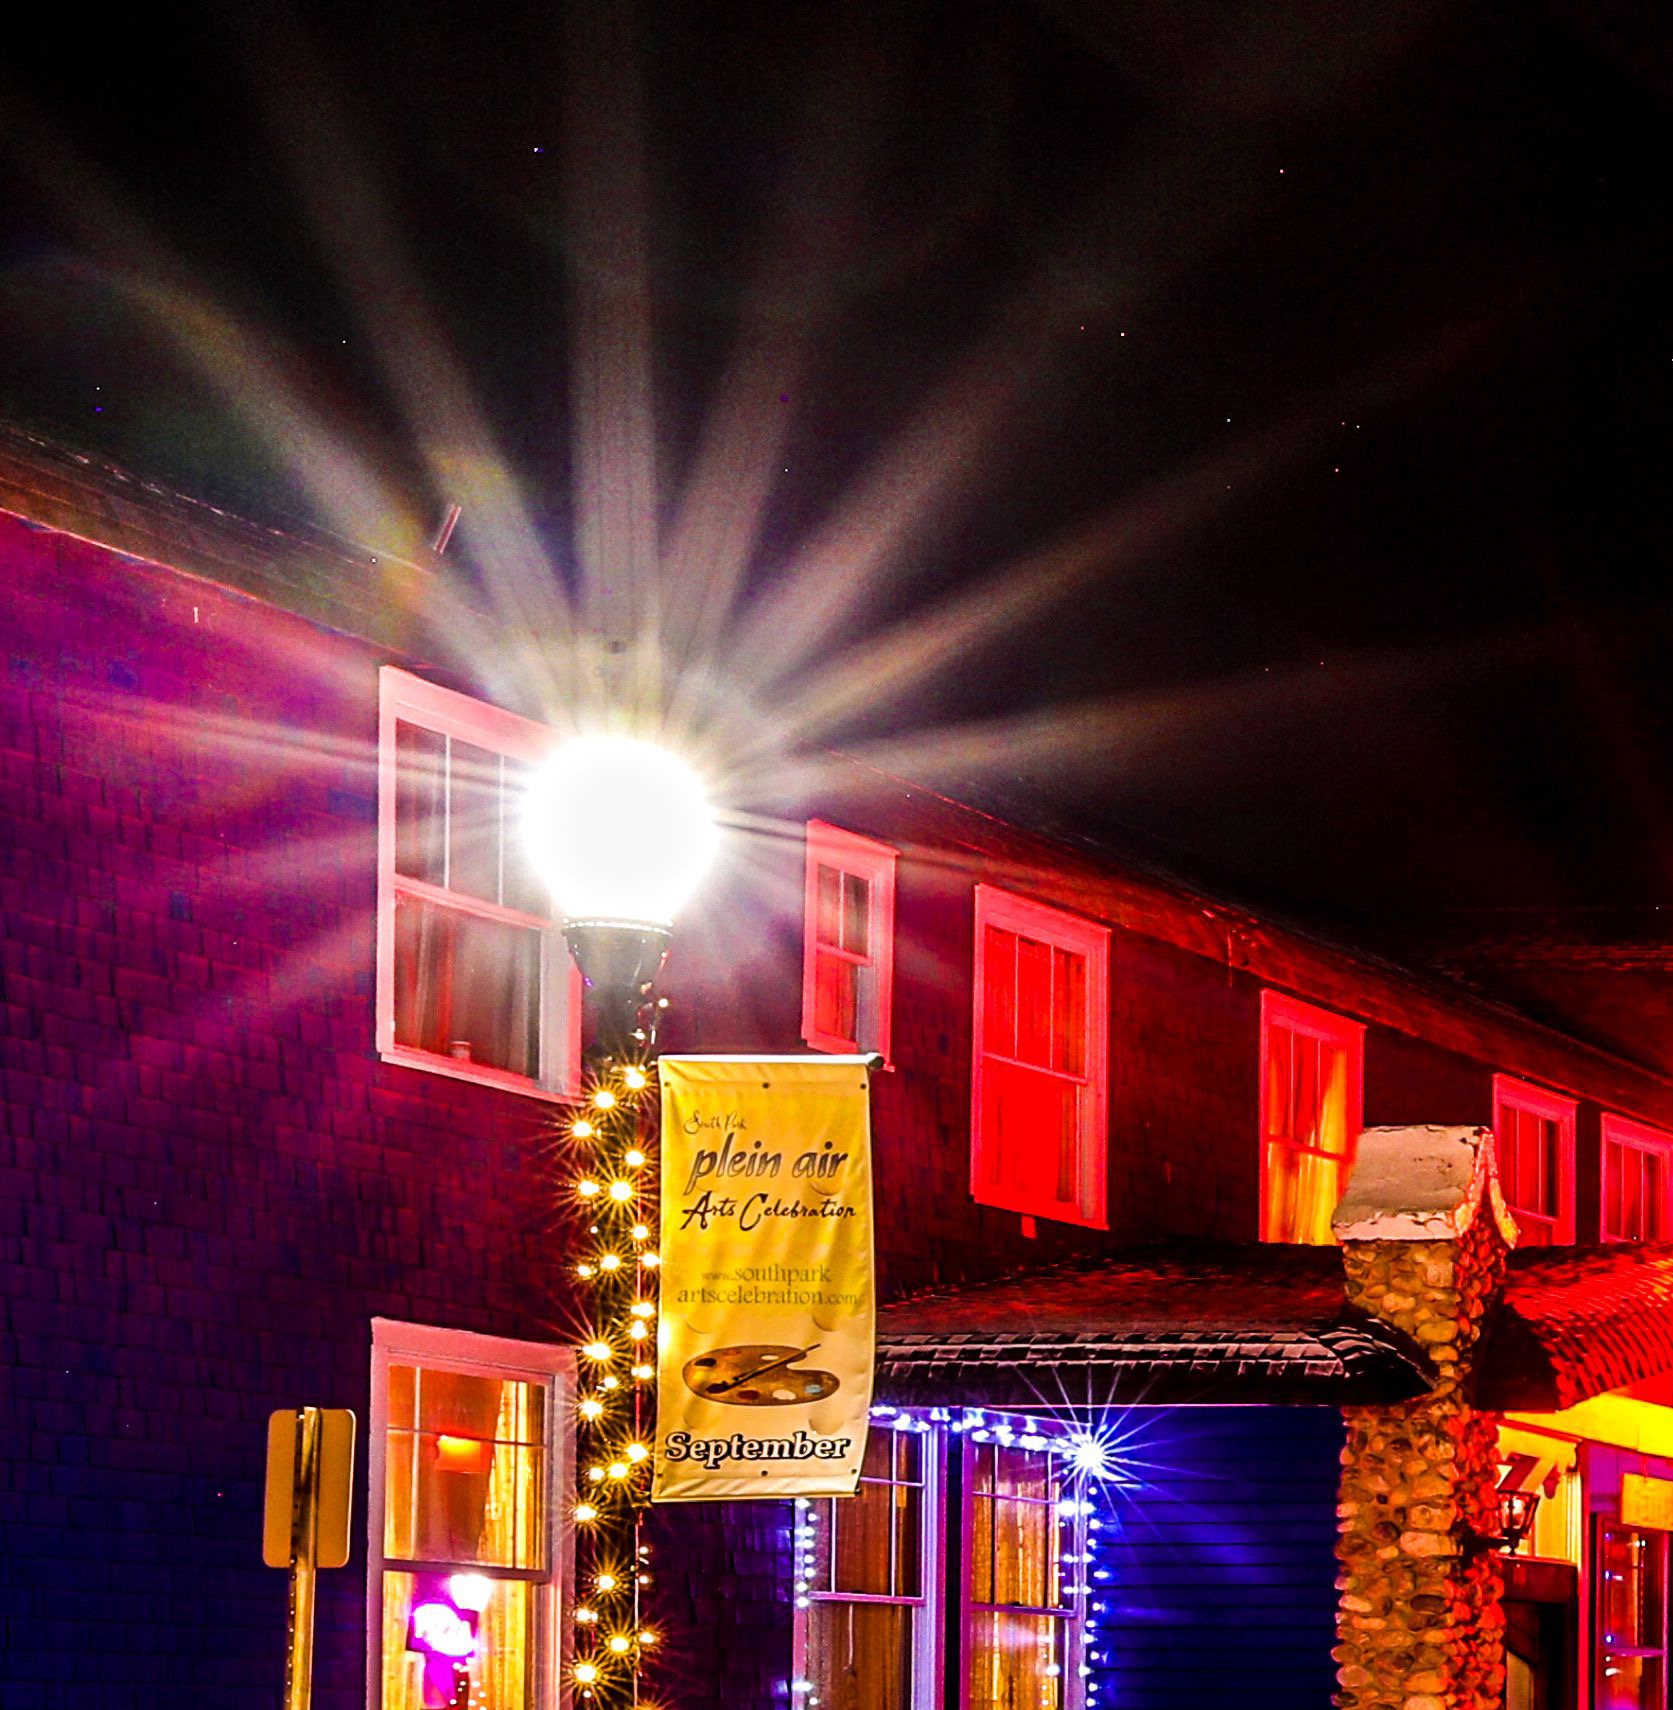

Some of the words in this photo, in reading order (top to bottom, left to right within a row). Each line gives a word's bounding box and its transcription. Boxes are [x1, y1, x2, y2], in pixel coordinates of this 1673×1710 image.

[683, 1131, 782, 1195] plein
[791, 1140, 848, 1178] air
[680, 1190, 738, 1230] Arts
[739, 1192, 857, 1231] Celebration
[701, 1264, 831, 1286] www.southpark
[677, 1285, 861, 1305] artscelebration.com
[665, 1431, 851, 1469] September
